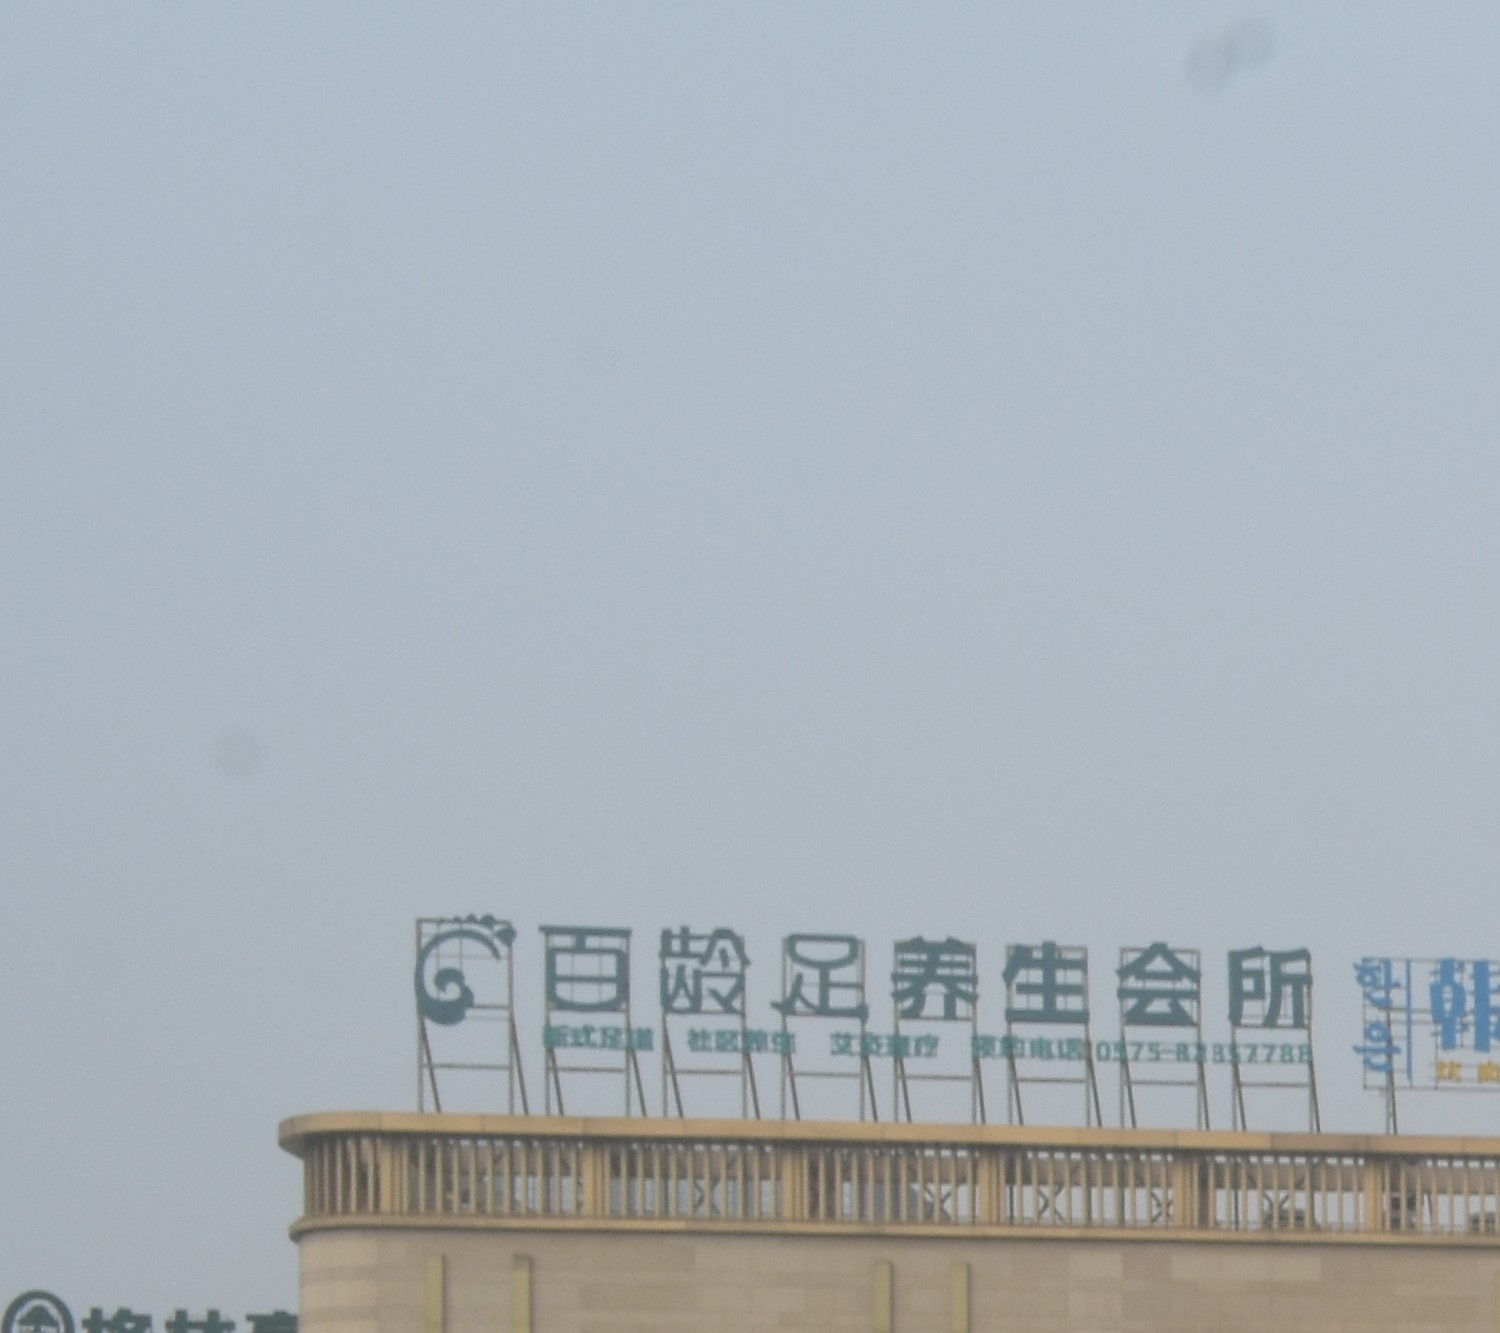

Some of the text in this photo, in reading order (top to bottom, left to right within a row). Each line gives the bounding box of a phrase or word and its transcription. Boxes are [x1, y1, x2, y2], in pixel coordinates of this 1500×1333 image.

[539, 925, 1310, 1029] 百龄足养生会所
